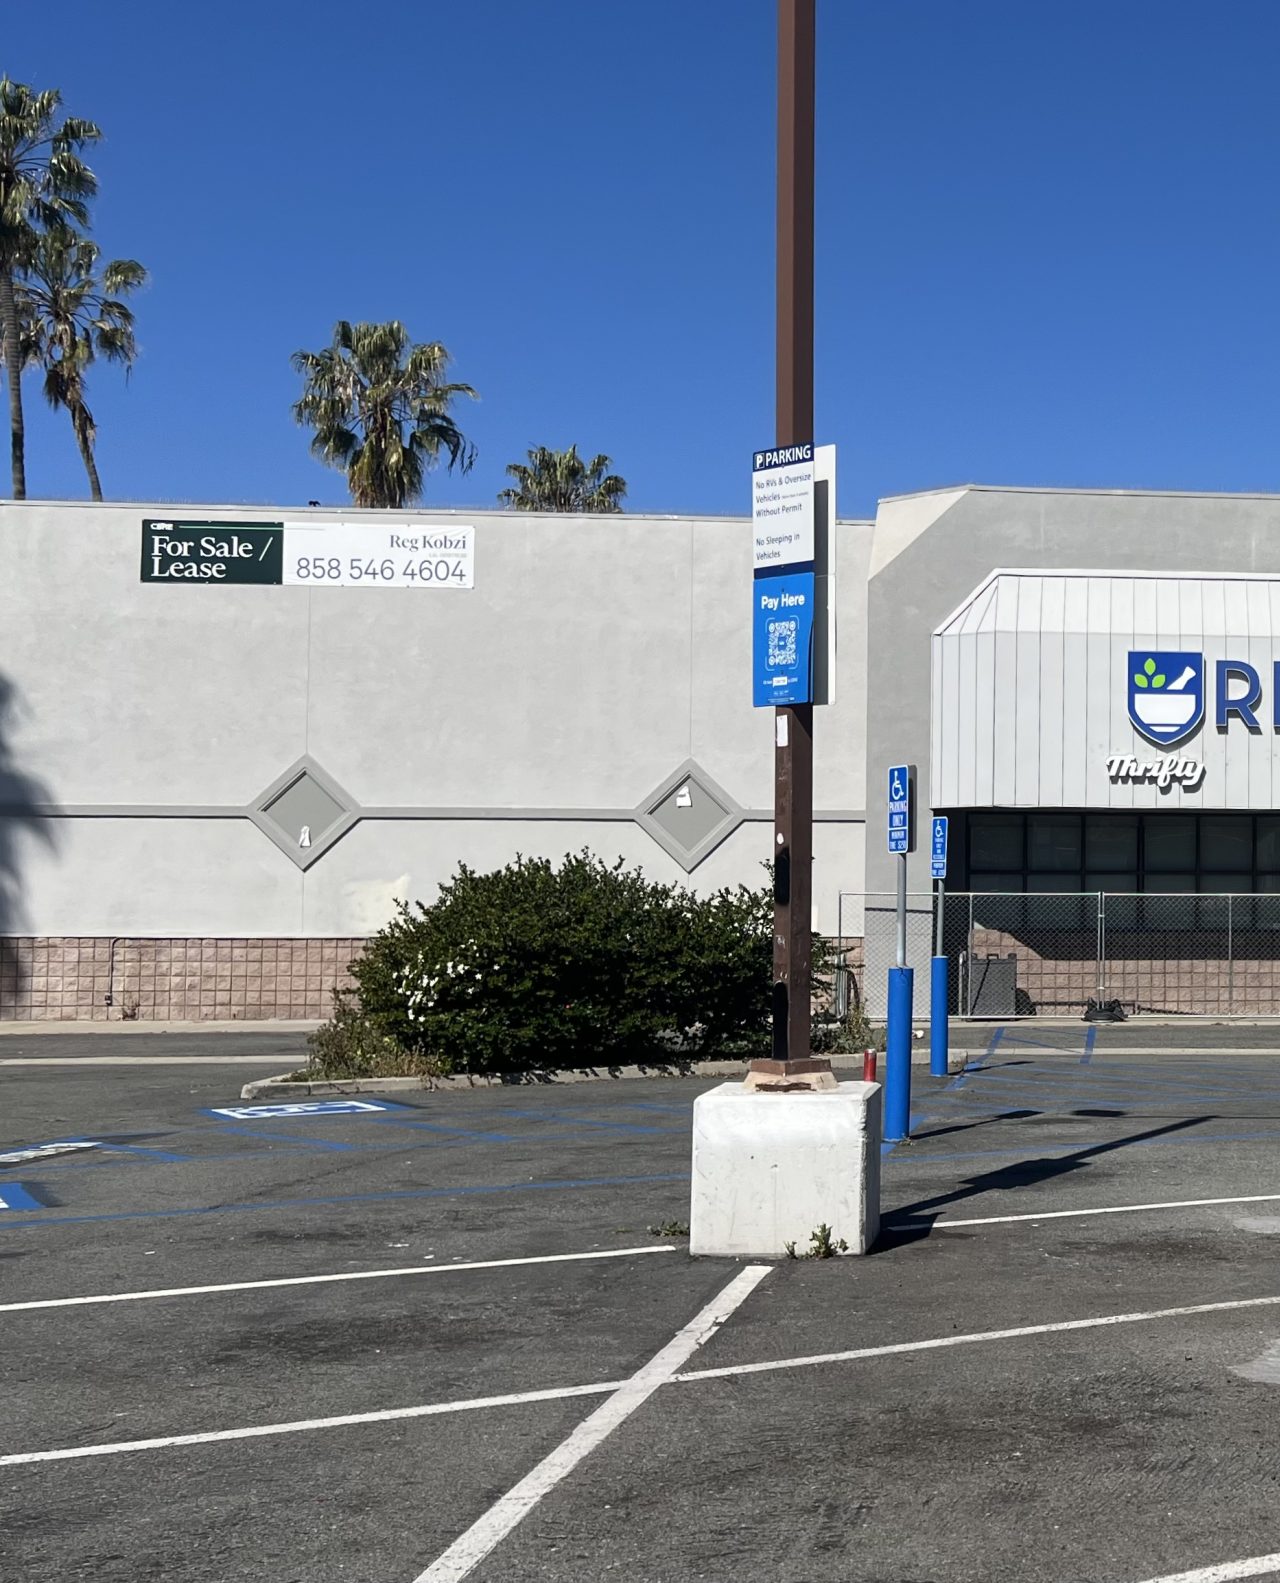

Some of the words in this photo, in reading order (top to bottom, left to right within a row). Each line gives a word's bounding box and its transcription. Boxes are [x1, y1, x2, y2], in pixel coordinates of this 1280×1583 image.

[765, 445, 811, 466] PARKING
[755, 481, 765, 489] No
[785, 474, 811, 485] Oversize
[755, 492, 781, 504] Vehicles
[755, 507, 780, 518] Without
[782, 503, 802, 514] Permit
[151, 535, 194, 557] For
[200, 536, 254, 558] Sale
[390, 534, 419, 552] Reg
[422, 535, 467, 549] Kobzi
[756, 538, 765, 547] No
[766, 534, 793, 545] Sleeping
[794, 533, 800, 541] in
[756, 550, 781, 561] Vehicles
[151, 556, 227, 578] Lease
[296, 557, 341, 579] 858
[349, 558, 395, 581] 546
[402, 559, 467, 582] 4604
[761, 595, 779, 611] Pay
[781, 593, 805, 608] Here
[1105, 754, 1205, 788] Thrifty
